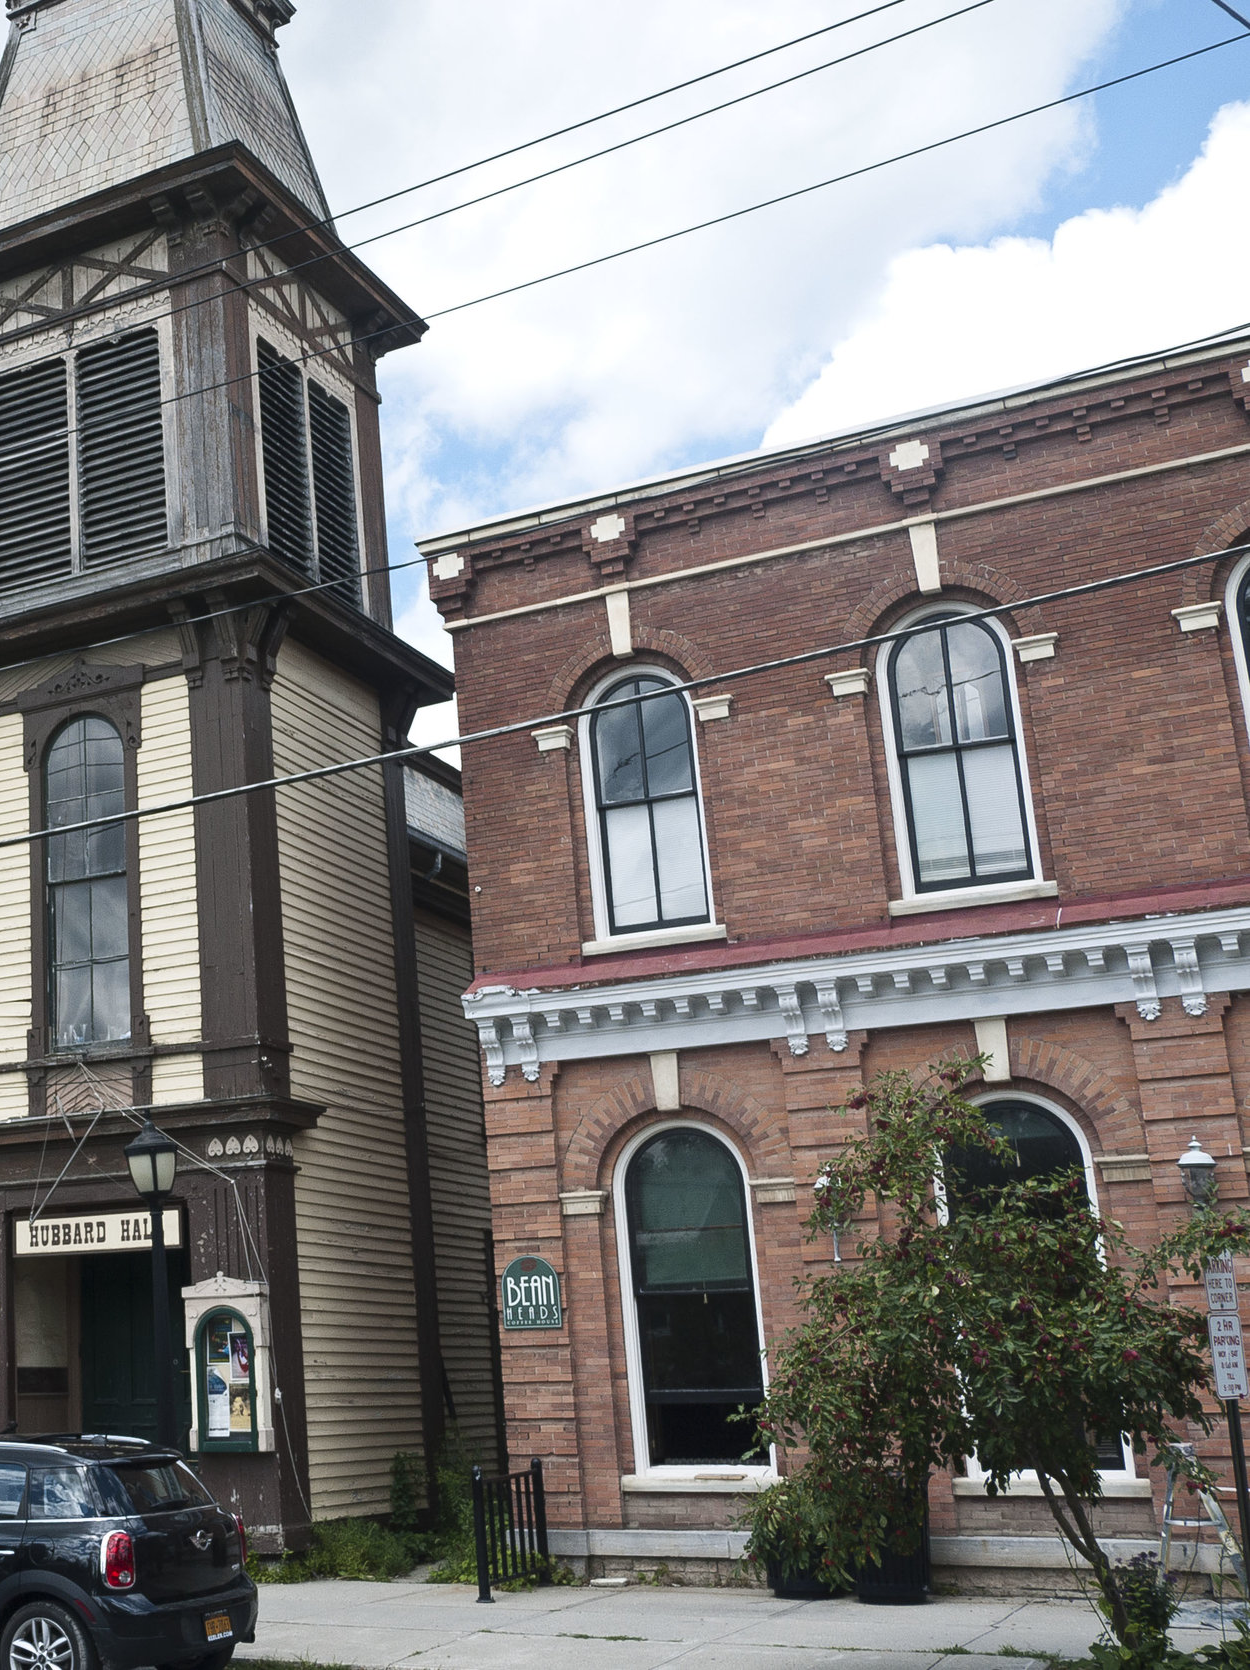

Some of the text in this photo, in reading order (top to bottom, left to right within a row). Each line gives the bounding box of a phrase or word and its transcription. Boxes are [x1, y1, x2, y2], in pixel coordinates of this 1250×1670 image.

[29, 1217, 152, 1247] HUBBARD HAL
[1208, 1277, 1233, 1289] HERE TO
[506, 1275, 554, 1306] BEAN
[1210, 1292, 1234, 1304] CORNER
[506, 1306, 558, 1320] HEADS
[1217, 1320, 1234, 1332] 2 HR
[1213, 1335, 1241, 1347] PARKING
